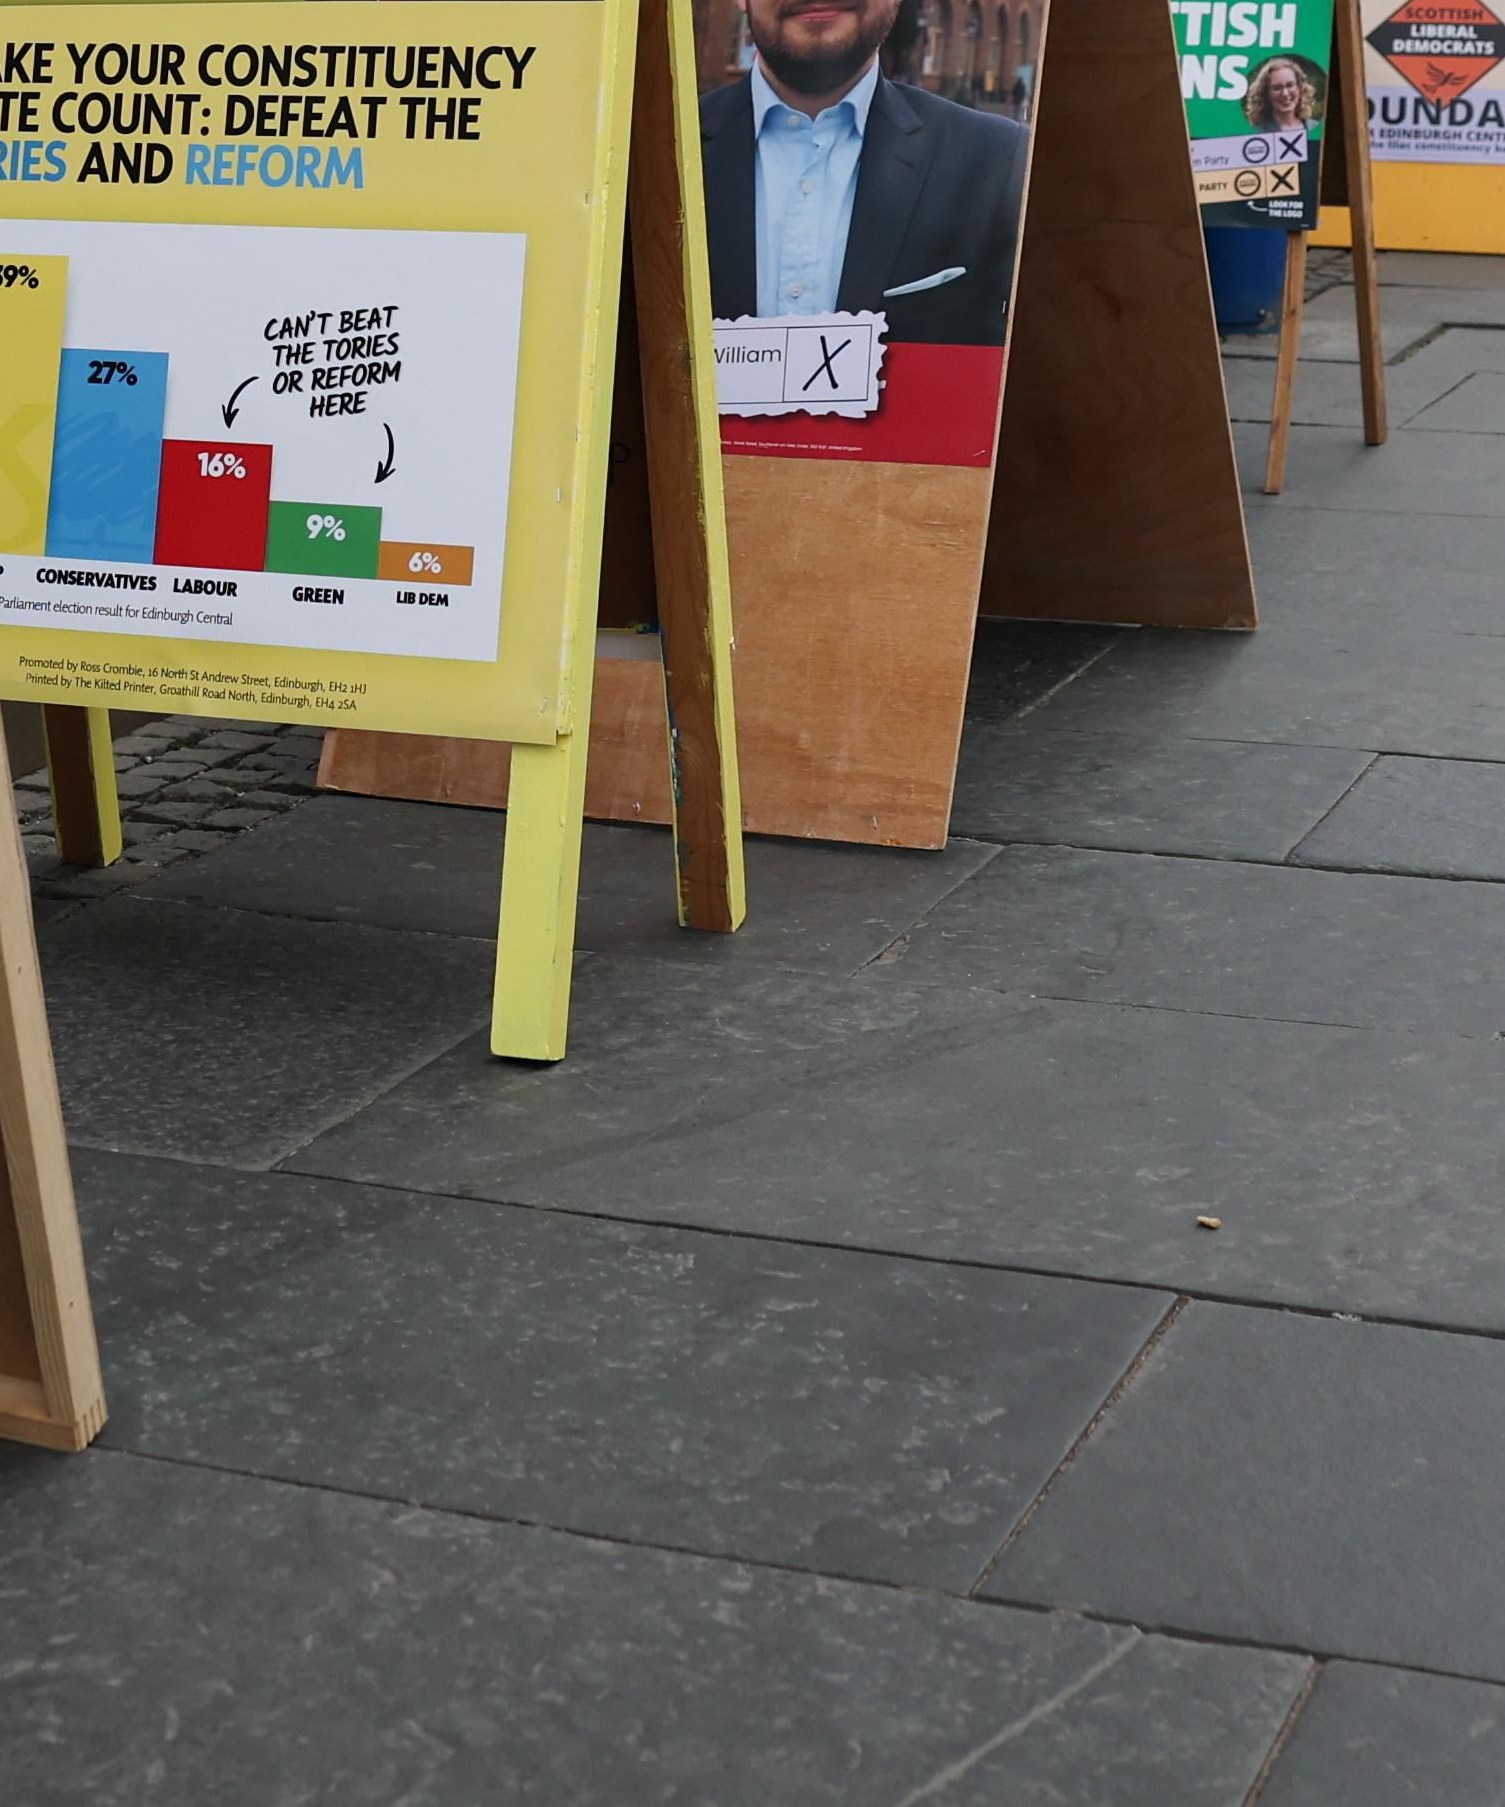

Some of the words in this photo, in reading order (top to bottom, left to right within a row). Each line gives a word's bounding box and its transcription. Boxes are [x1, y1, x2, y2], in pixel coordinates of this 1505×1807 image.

[1404, 6, 1484, 21] SCOTTISH
[1410, 24, 1478, 40] LIBERAL
[1392, 39, 1496, 56] DEMOCRATS
[66, 44, 187, 87] YOUR
[197, 44, 537, 90] CONSTITUENCY
[52, 92, 212, 136] COUNT:
[224, 95, 387, 139] DEFEAT
[399, 97, 482, 141] THE
[1380, 128, 1462, 141] EDINBURGH
[76, 142, 174, 184] AND
[184, 144, 365, 189] REFORM
[1199, 182, 1228, 191] PARTY
[1269, 200, 1287, 209] LOOK
[1269, 209, 1282, 217] THE
[1283, 209, 1303, 218] LOGO
[263, 310, 333, 342] CAN'T
[337, 305, 399, 336] BEAT
[272, 341, 316, 368] THE
[321, 332, 400, 364] TORIES
[86, 361, 138, 386] 27%
[271, 369, 304, 395] OR
[310, 360, 402, 392] REFORM
[309, 391, 367, 418] HERE
[197, 452, 246, 480] 16%
[306, 514, 346, 542] 9%
[407, 551, 443, 575] 6%
[36, 568, 157, 591] CONSERVATIVES
[173, 578, 238, 597] LABOUR
[292, 586, 345, 605] GREEN
[396, 591, 416, 605] LIB
[418, 592, 449, 607] DEM
[53, 599, 92, 614] election
[95, 604, 122, 617] result
[125, 605, 139, 618] for
[142, 606, 194, 625] Edinburgh
[196, 611, 233, 626] Central
[19, 656, 64, 670] Promoted
[66, 659, 78, 672] by
[80, 661, 101, 673] Ross
[103, 662, 145, 677] Crombie,
[148, 666, 159, 678] 16
[161, 667, 188, 680] North
[190, 669, 200, 681] St
[201, 670, 239, 684] Andrew
[241, 674, 271, 689] Street,
[274, 676, 325, 693] Edinburgh,
[329, 681, 347, 692] EH2
[25, 673, 58, 686] Printed
[60, 676, 72, 689] by
[75, 677, 92, 689] The
[94, 678, 121, 691] Kilted
[123, 682, 157, 695] Printer,
[159, 683, 200, 697] Groathill
[202, 687, 226, 700] Road
[228, 690, 258, 704] North,
[261, 692, 312, 709] Edinburgh,
[315, 697, 335, 710] EH4
[338, 699, 357, 711] 2SA
